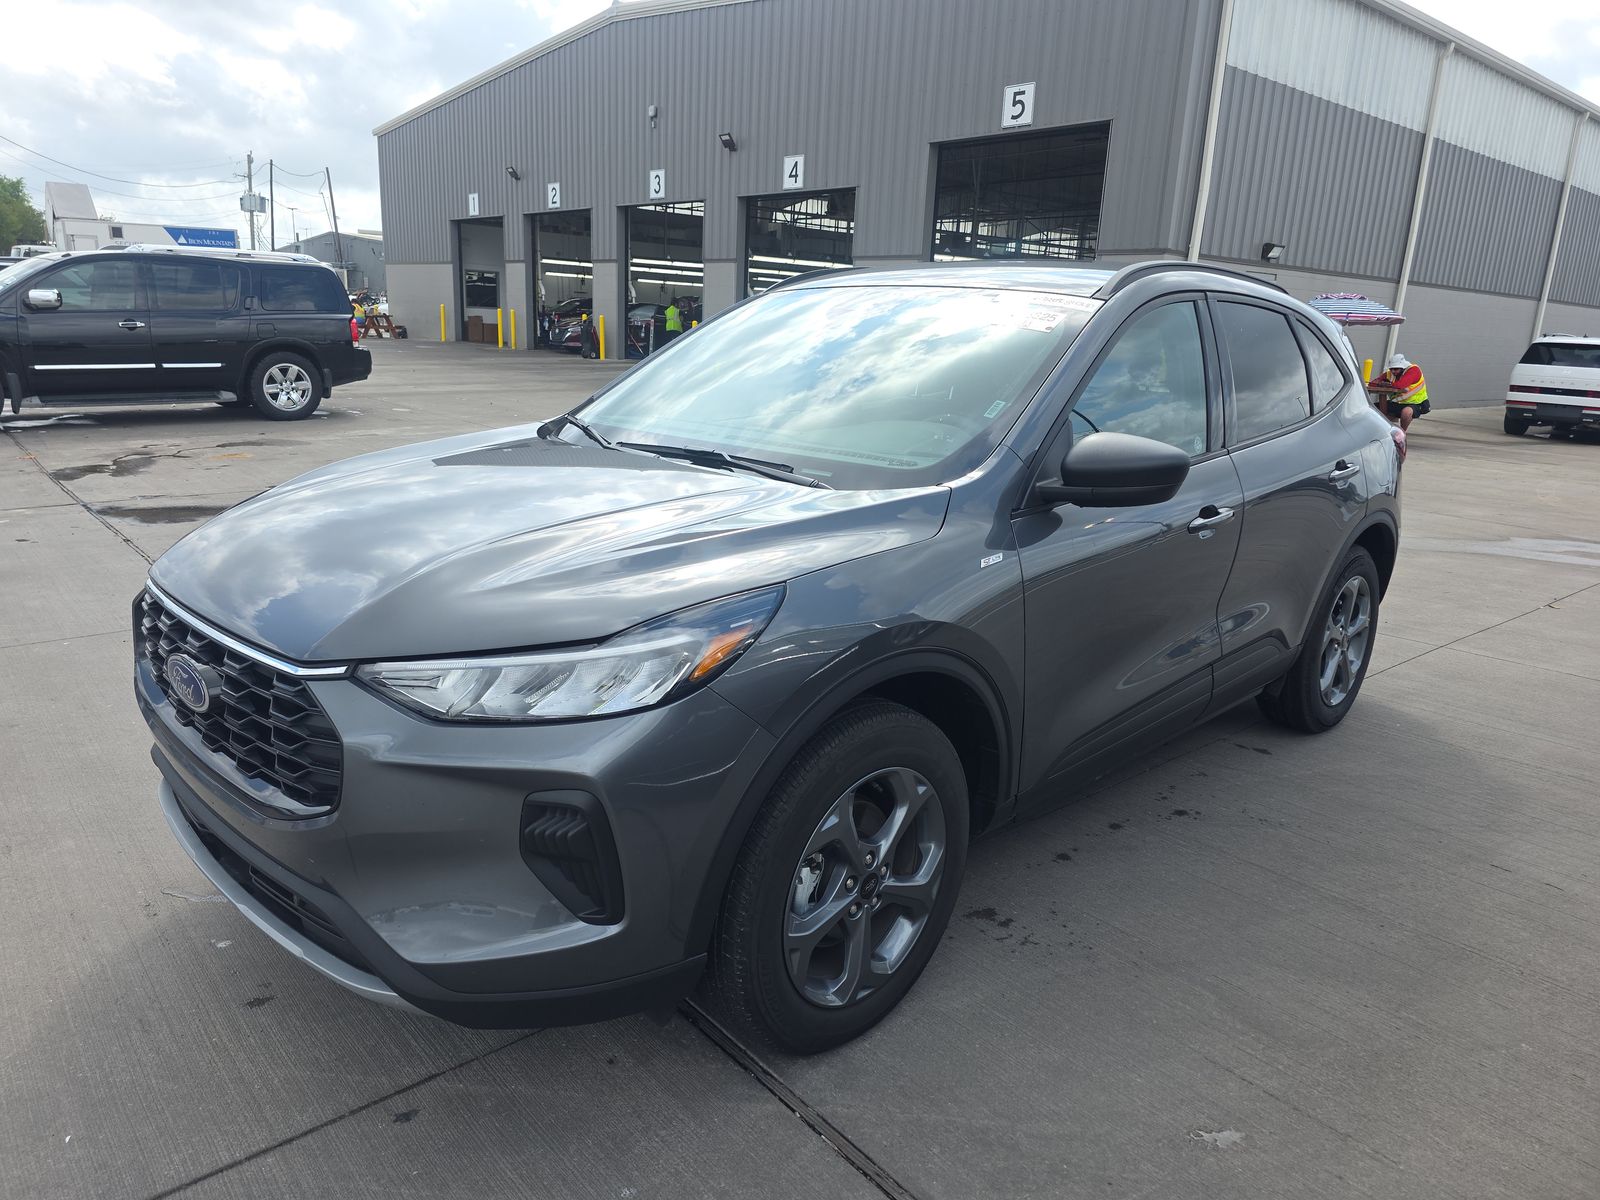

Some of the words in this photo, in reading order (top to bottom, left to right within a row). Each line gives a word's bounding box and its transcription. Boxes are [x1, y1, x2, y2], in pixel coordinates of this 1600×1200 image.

[1010, 90, 1026, 120] 5
[788, 160, 799, 184] 4
[550, 186, 557, 204] 2
[653, 174, 661, 194] 3
[203, 239, 234, 247] MOUNTAIN
[172, 666, 196, 702] Ford
